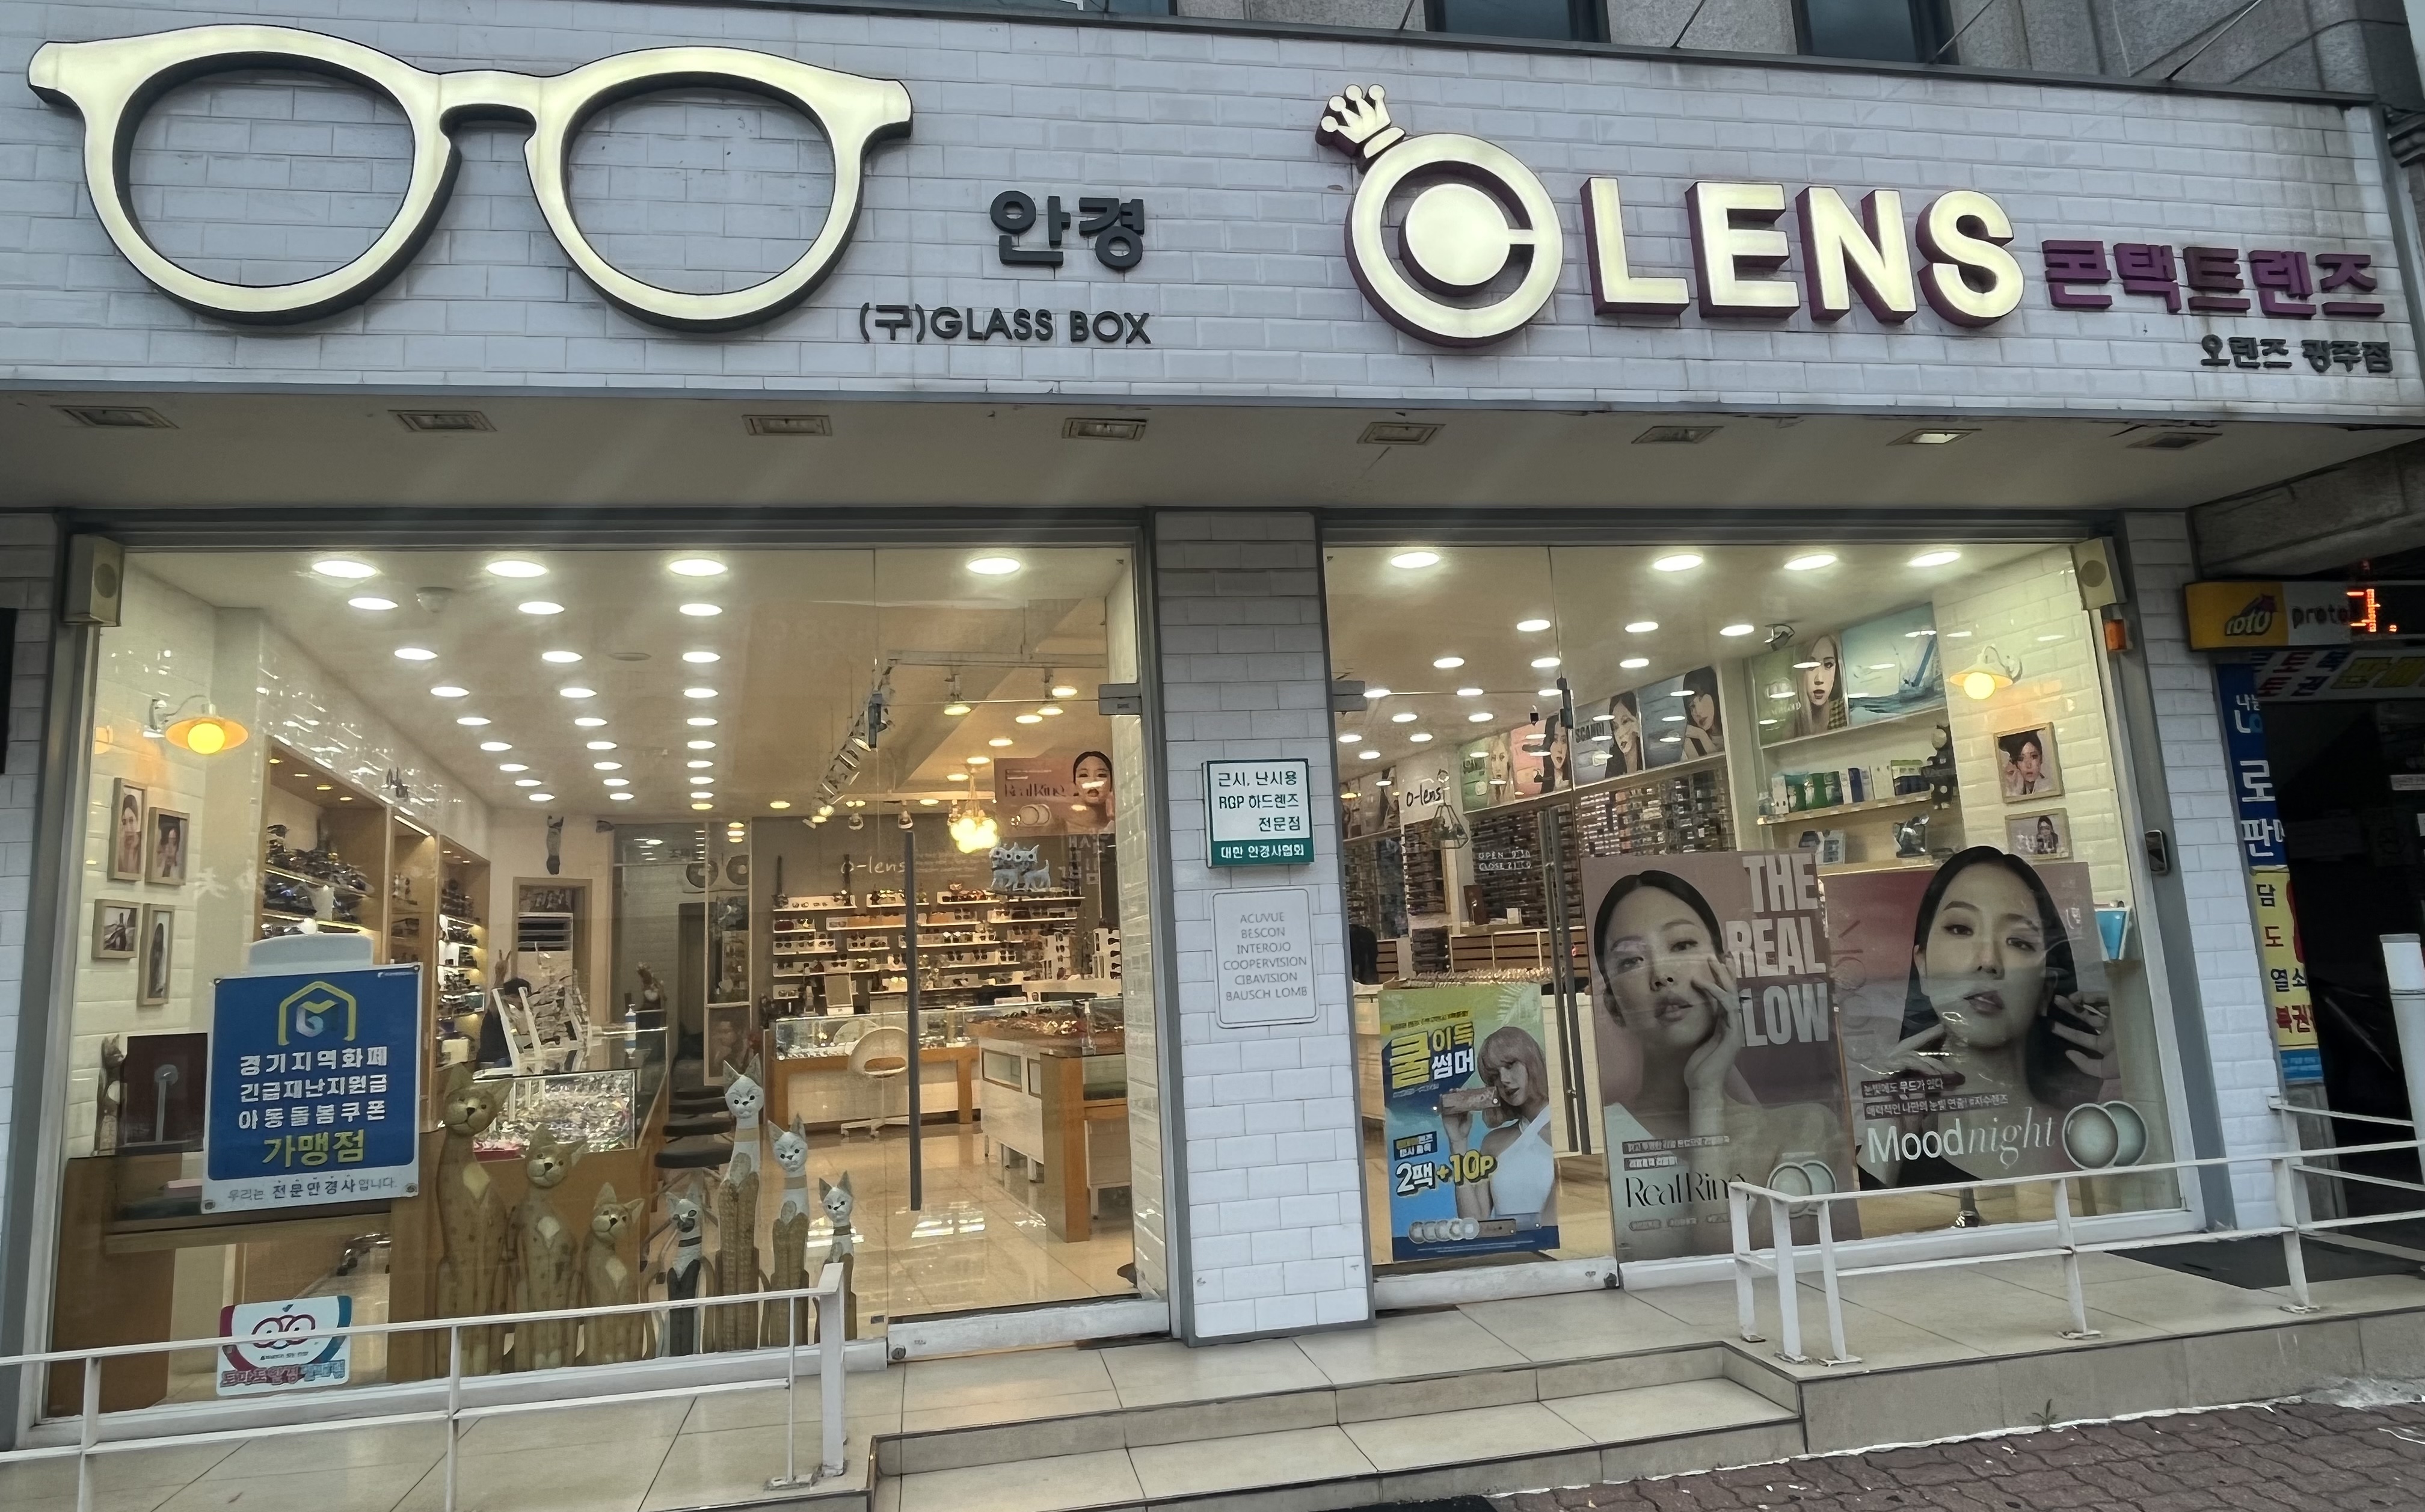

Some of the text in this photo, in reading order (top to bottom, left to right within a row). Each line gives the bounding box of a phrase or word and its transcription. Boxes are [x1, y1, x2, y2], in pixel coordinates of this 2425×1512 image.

[990, 190, 1145, 271] 안경
[2042, 239, 2385, 320] 콘택트렌즈
[1070, 309, 1151, 345] BOX
[2201, 334, 2393, 373] 오렌즈 광주점
[1256, 770, 1297, 786] 난시용
[1219, 793, 1299, 809] RGP 하드렌즈
[1406, 784, 1443, 807] o-lens
[1258, 816, 1300, 832] 전문점
[1742, 853, 1819, 913] THE
[1240, 912, 1285, 924] ACUVUE
[1241, 927, 1285, 939] BESCON
[2264, 926, 2284, 947] 도
[1237, 942, 1291, 954] INTEROJO
[1725, 917, 1827, 979] REAL
[1223, 956, 1307, 971] COOPERVISION
[1235, 973, 1297, 985] CIBAVISION
[1226, 986, 1308, 1001] BAUSCH LOMB
[1739, 982, 1830, 1048] LOW
[240, 1046, 388, 1076] 경기지역화폐
[1431, 1048, 1474, 1080] 썸머
[241, 1074, 388, 1103] 긴급재난지원금
[1899, 1080, 1925, 1093] 무드가
[262, 1129, 365, 1168] 가맹점
